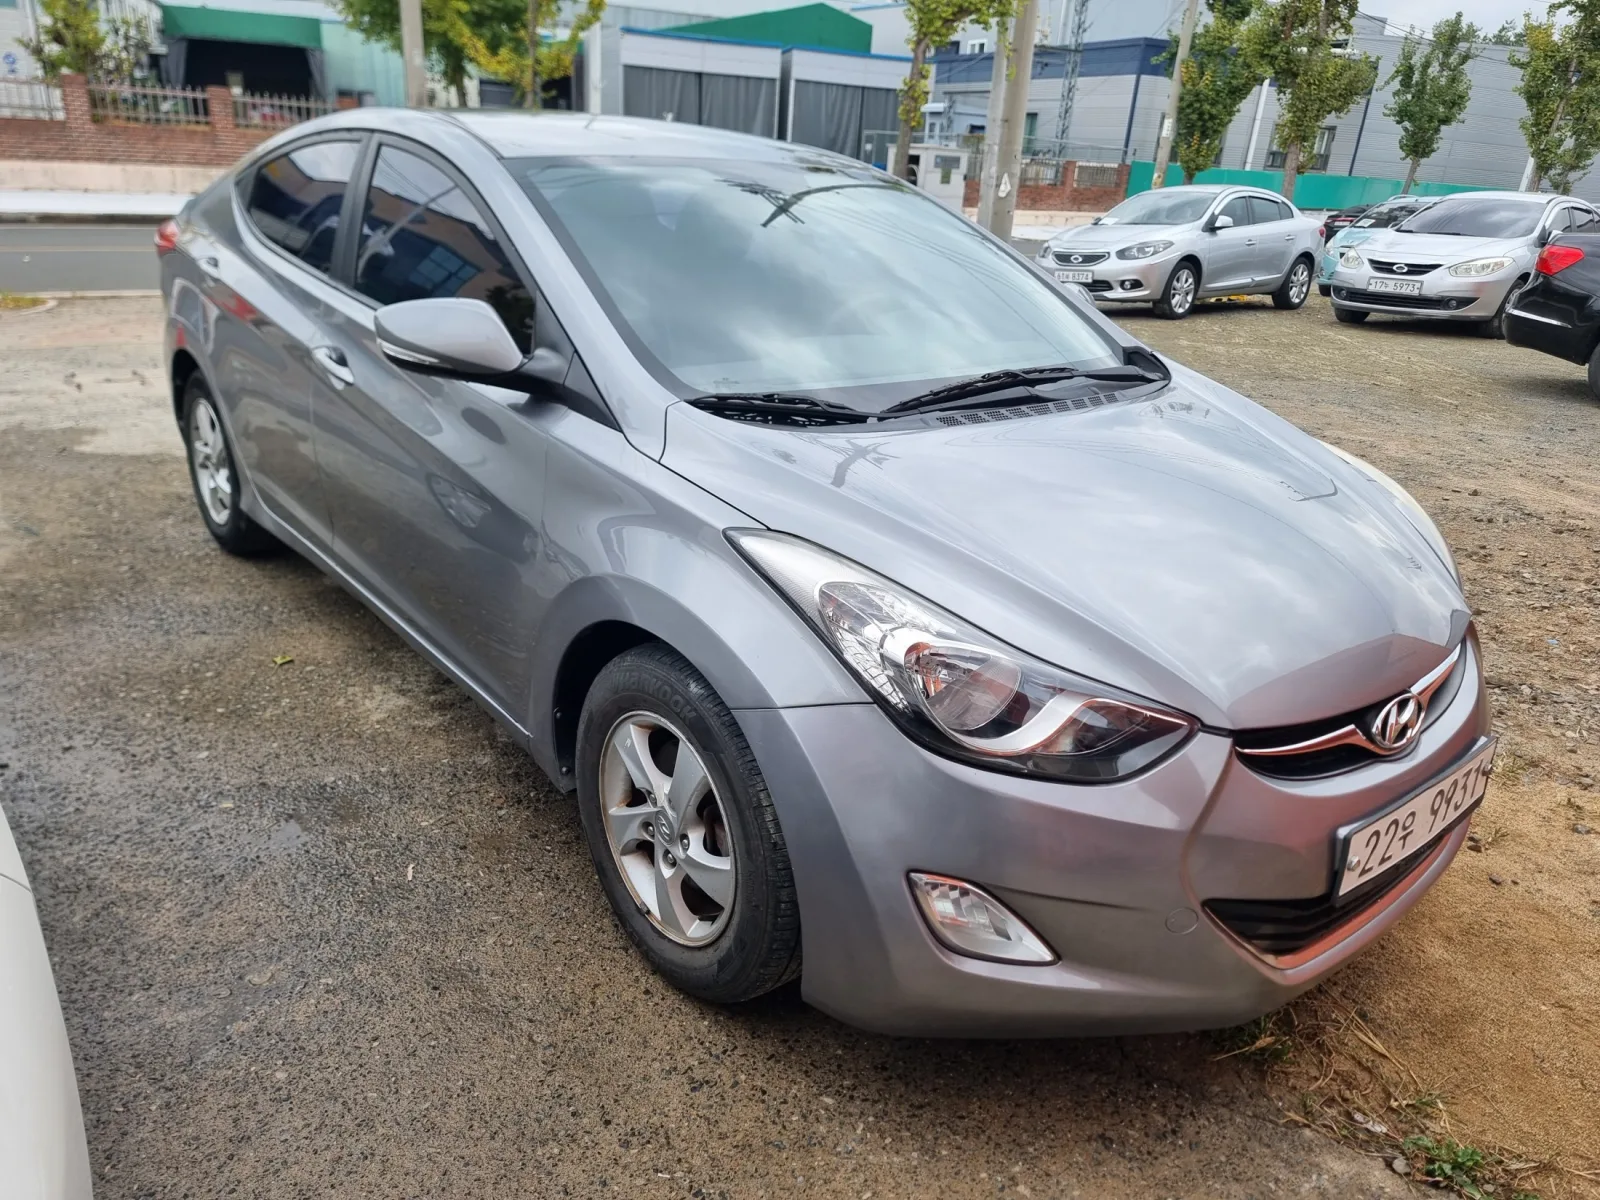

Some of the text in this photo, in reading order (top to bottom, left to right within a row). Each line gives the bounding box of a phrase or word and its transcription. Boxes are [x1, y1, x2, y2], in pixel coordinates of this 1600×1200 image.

[1392, 282, 1416, 293] 5973
[1357, 758, 1485, 879] 22우 9931
